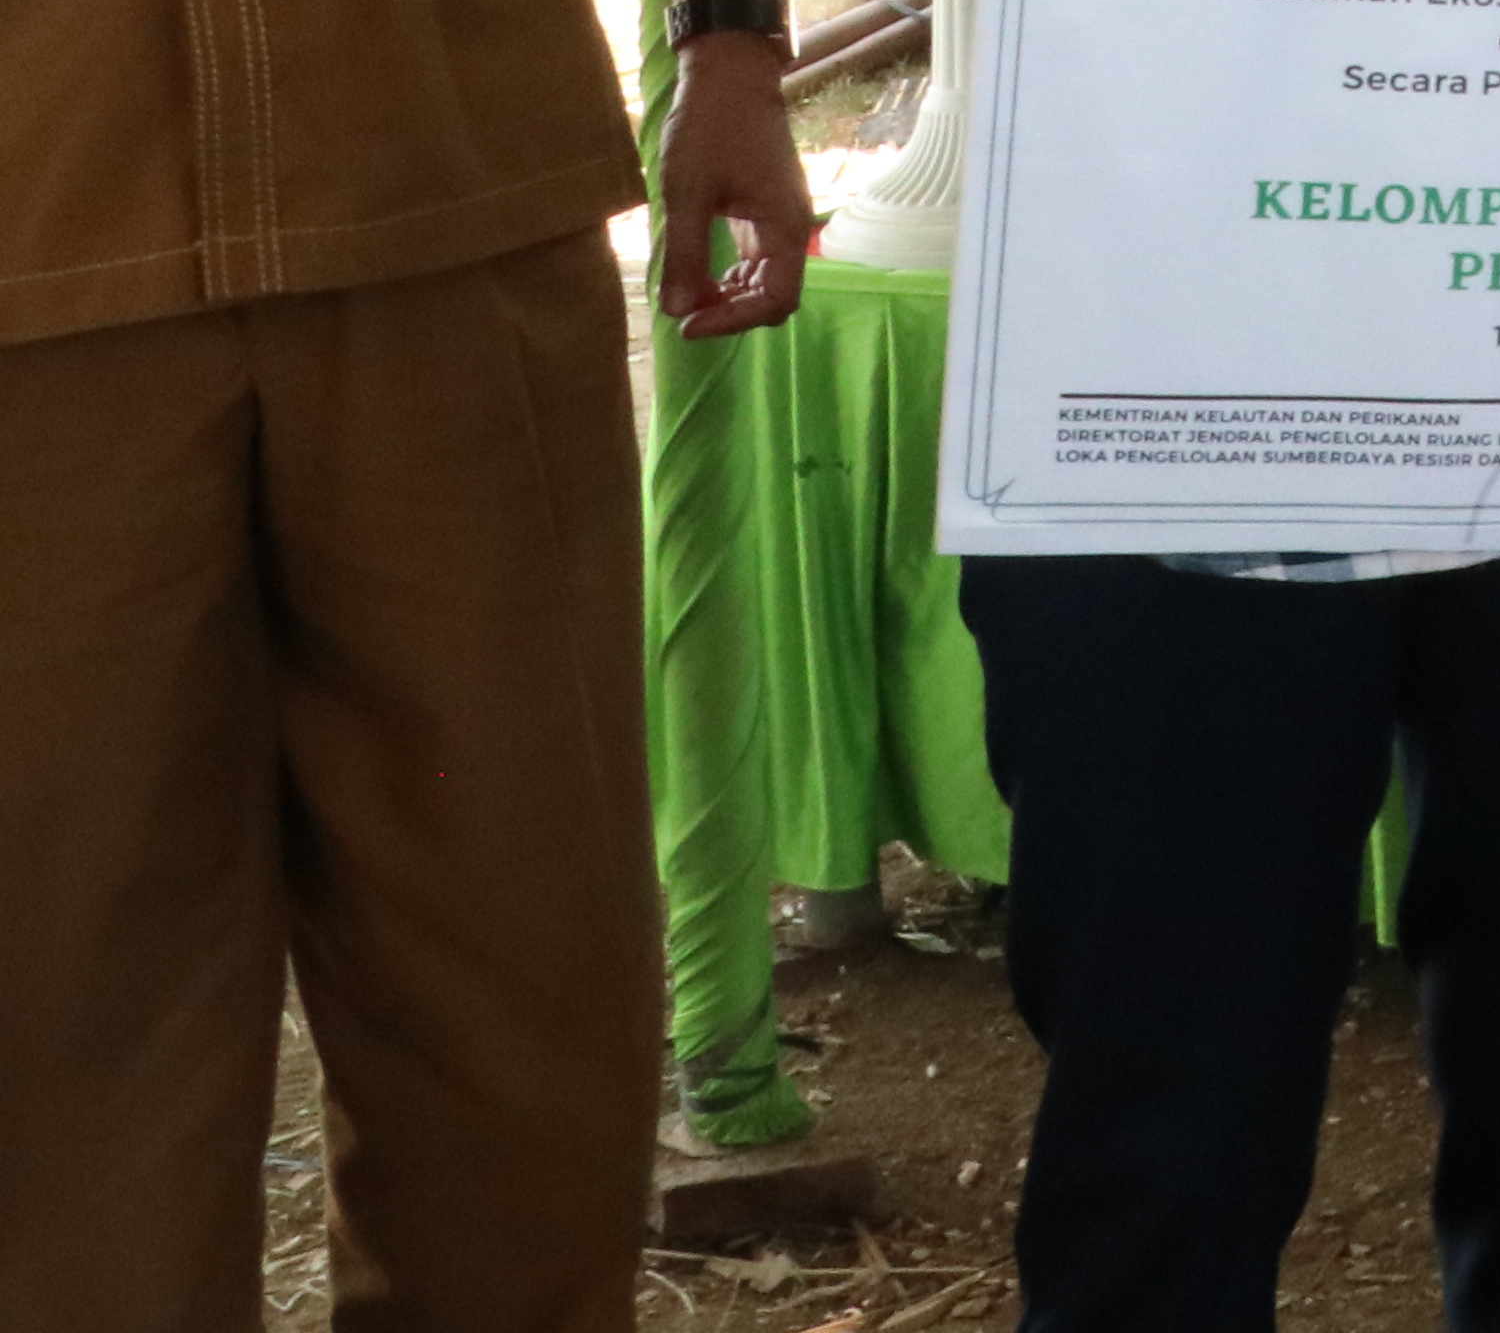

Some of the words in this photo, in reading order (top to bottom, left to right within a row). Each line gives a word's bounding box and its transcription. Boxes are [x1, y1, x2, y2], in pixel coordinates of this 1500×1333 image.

[1342, 64, 1467, 94] Secara
[1058, 407, 1187, 422] KEMENTRIAN
[1193, 409, 1294, 423] KELAUTAN
[1300, 409, 1342, 423] DAN
[1348, 410, 1460, 426] PERIKANAN
[1056, 428, 1181, 443] DIREKTORAT
[1186, 429, 1272, 444] JENDRAL
[1279, 429, 1420, 445] PENGELOLAAN
[1426, 432, 1491, 446] RUANG
[1055, 449, 1108, 463] LOKA
[1114, 449, 1256, 464] PENGELOLAAN
[1263, 450, 1396, 465] SUMBERDAYA
[1402, 453, 1472, 467] PESISIR
